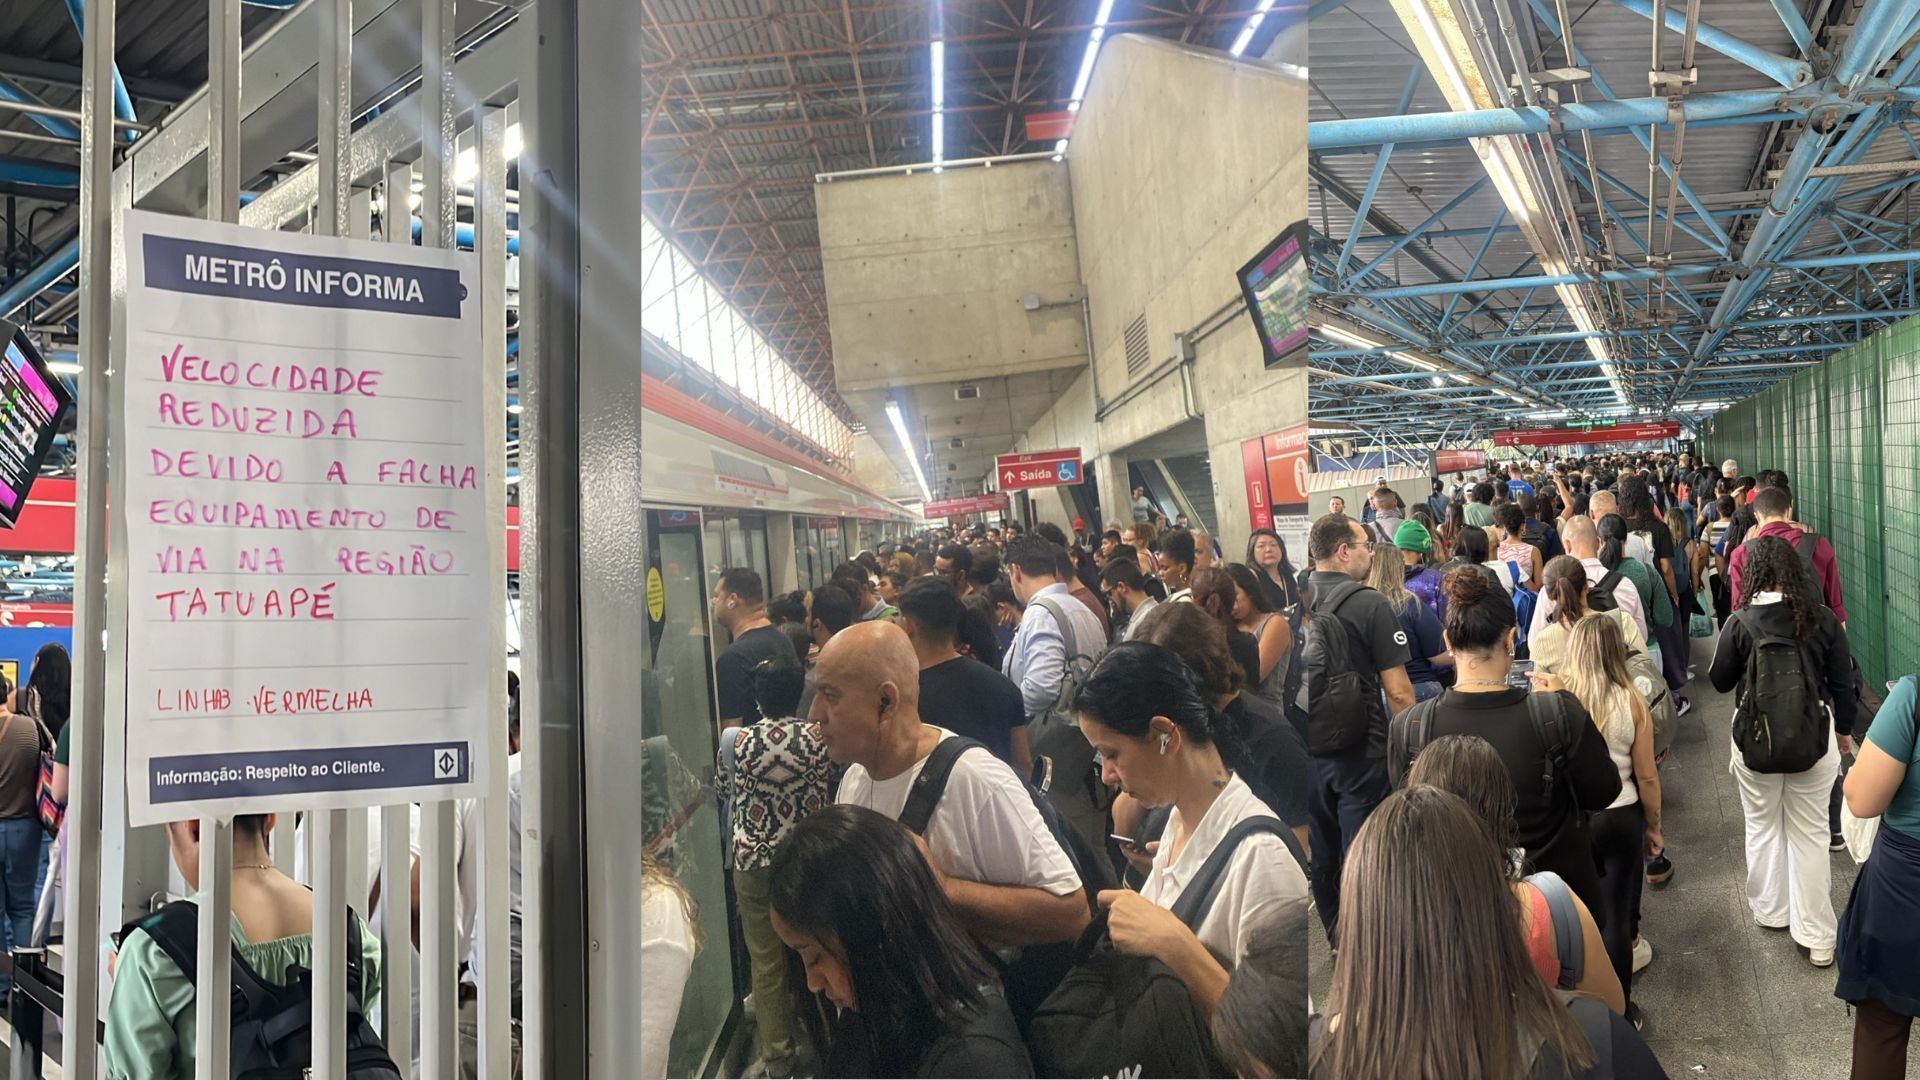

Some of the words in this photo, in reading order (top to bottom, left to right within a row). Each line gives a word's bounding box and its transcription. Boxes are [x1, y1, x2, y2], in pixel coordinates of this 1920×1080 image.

[185, 254, 287, 291] METRÔ
[295, 268, 425, 304] INFORMA
[161, 344, 384, 397] VELOCIDADE
[159, 392, 357, 439] REDUZIDA
[151, 448, 283, 484] DEVIDO
[327, 460, 348, 485] A
[1020, 468, 1052, 481] Saída
[149, 500, 387, 531] EQUIPAMENTO
[416, 506, 457, 531] DE
[156, 546, 208, 574] VIA
[239, 546, 285, 573] NA
[336, 545, 454, 576] REGIÃO
[156, 582, 337, 621] TATUAPÉ
[156, 766, 242, 787] Informação:
[245, 763, 308, 783] Respeito
[311, 764, 329, 777] ao
[332, 759, 386, 777] Cliente.
